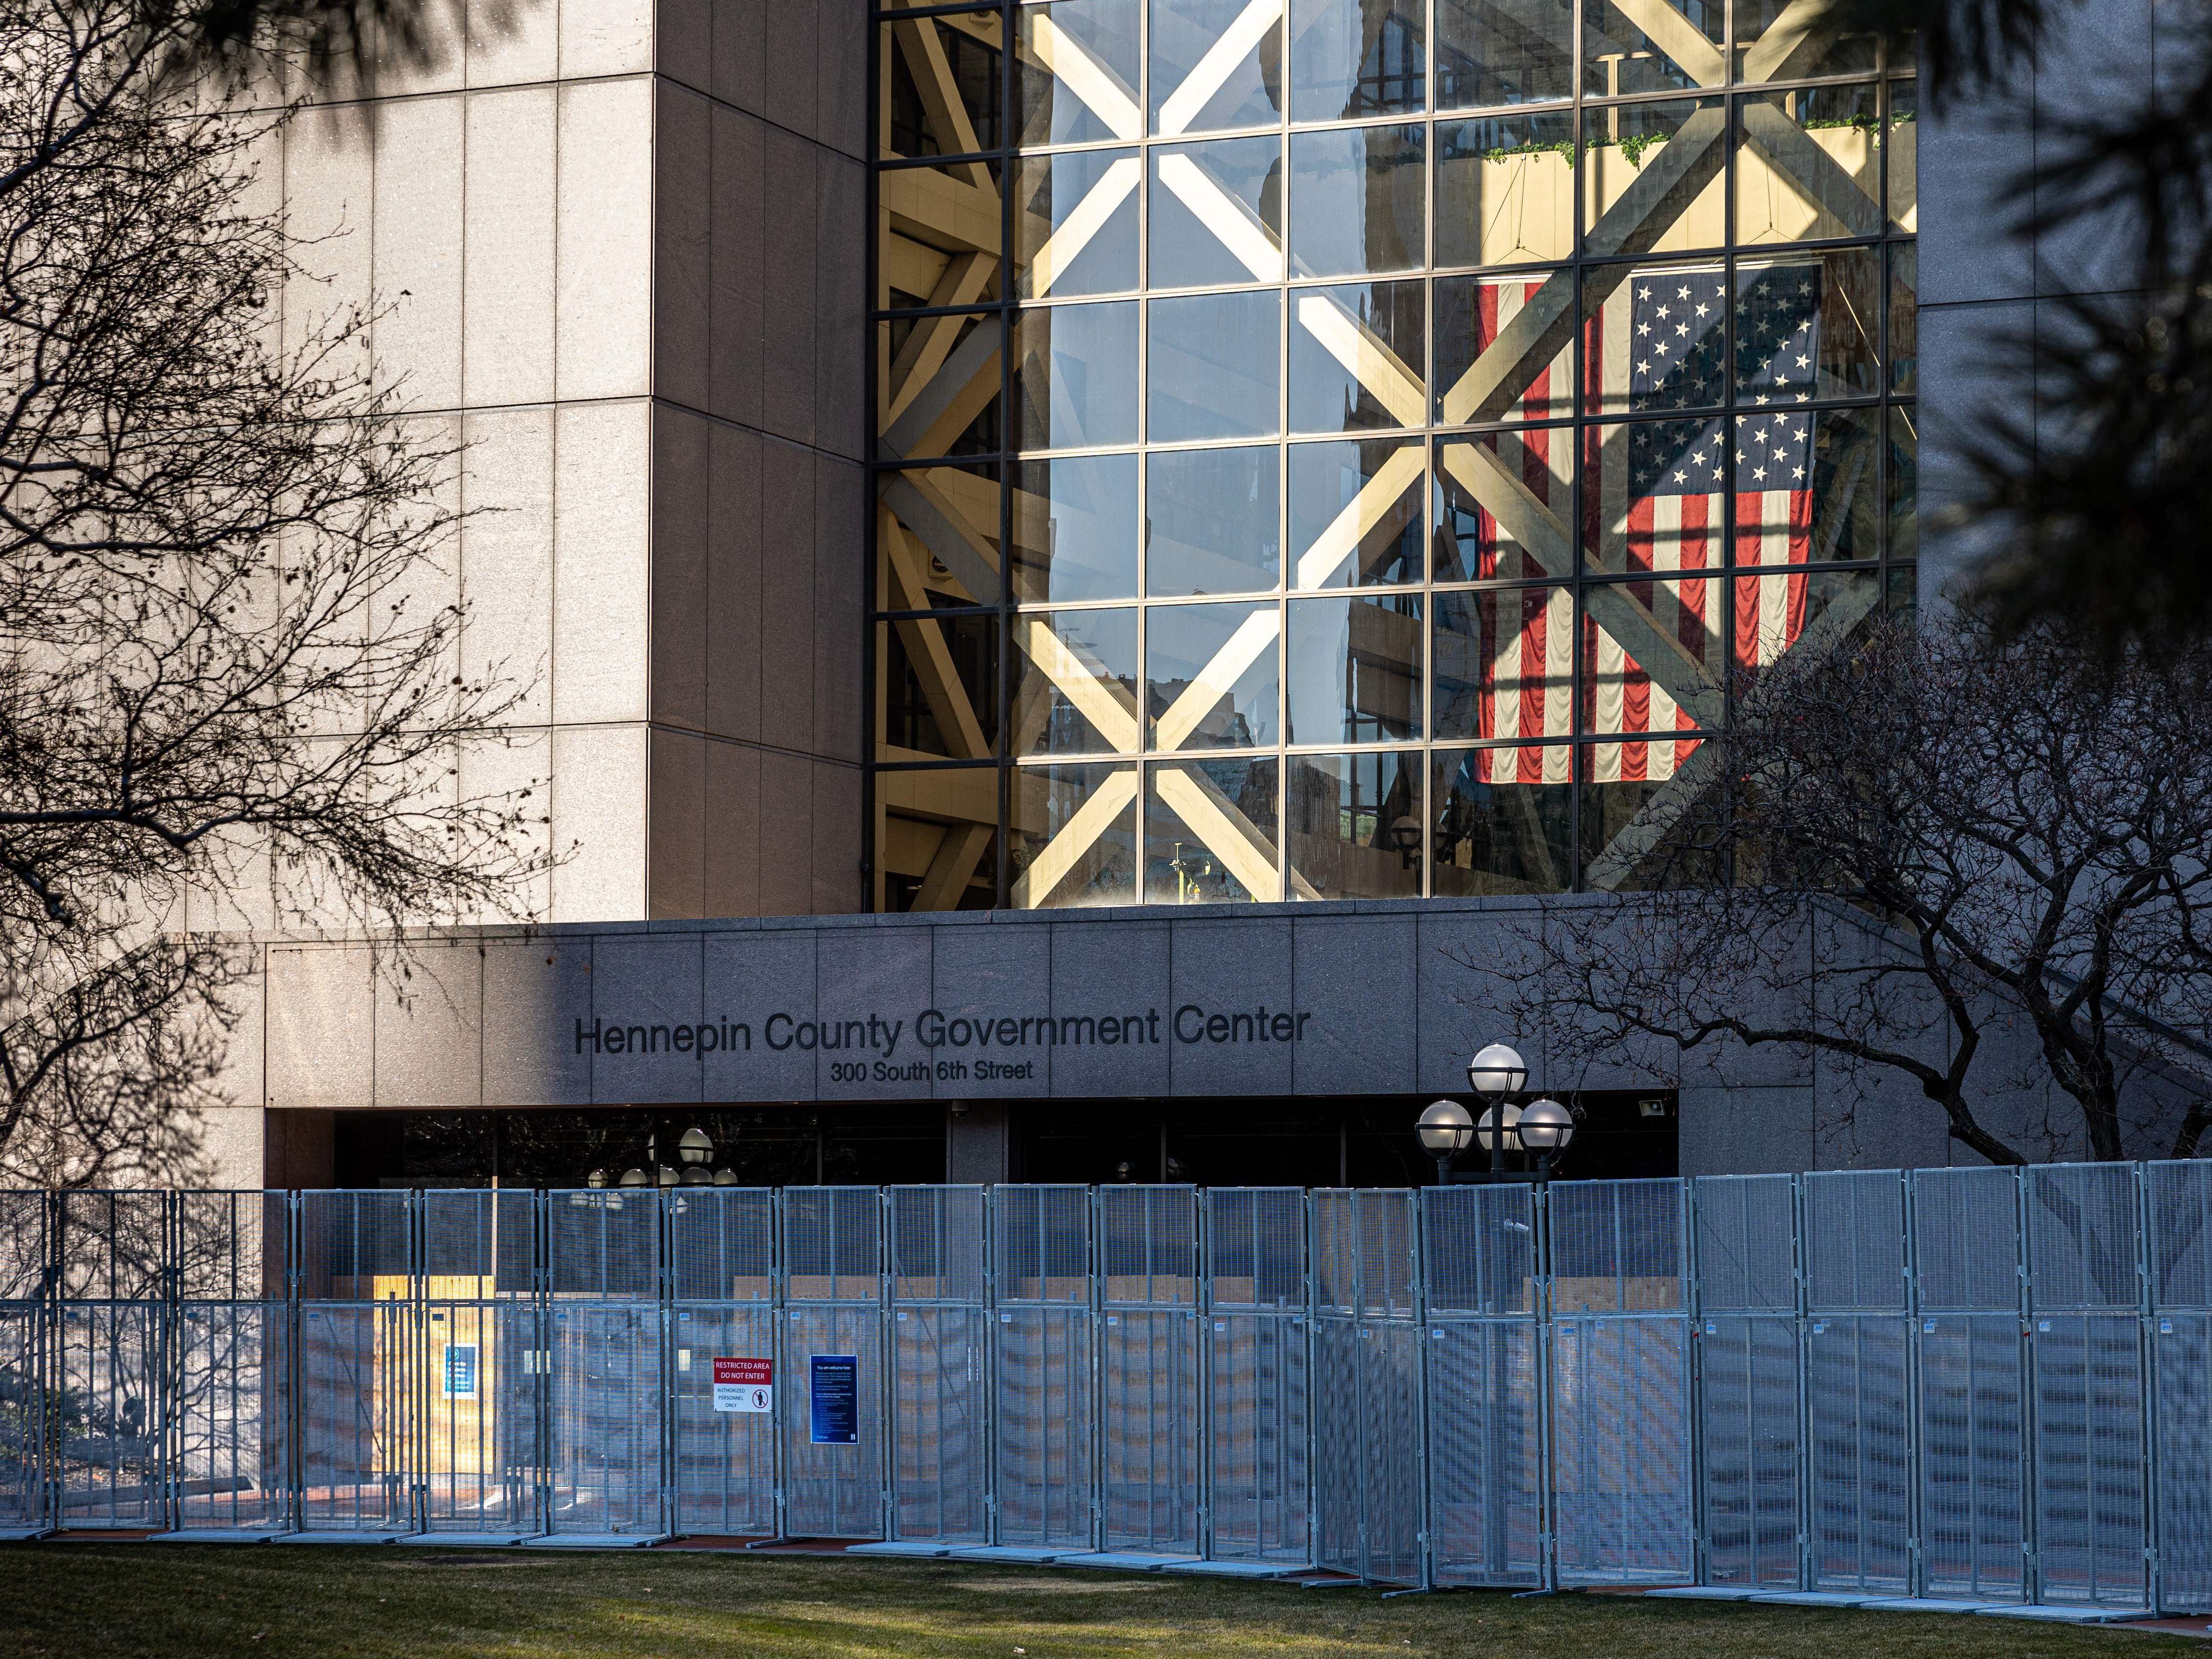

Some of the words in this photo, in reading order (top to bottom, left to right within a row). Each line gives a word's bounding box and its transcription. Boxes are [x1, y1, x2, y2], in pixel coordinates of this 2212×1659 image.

[575, 1015, 751, 1061] Hennepin
[765, 1012, 903, 1057] County
[916, 1009, 1159, 1047] Government
[1174, 1005, 1311, 1044] Center
[831, 1062, 867, 1081] 300
[872, 1061, 930, 1081] South
[936, 1061, 968, 1080] 6th
[974, 1060, 1033, 1080] Street
